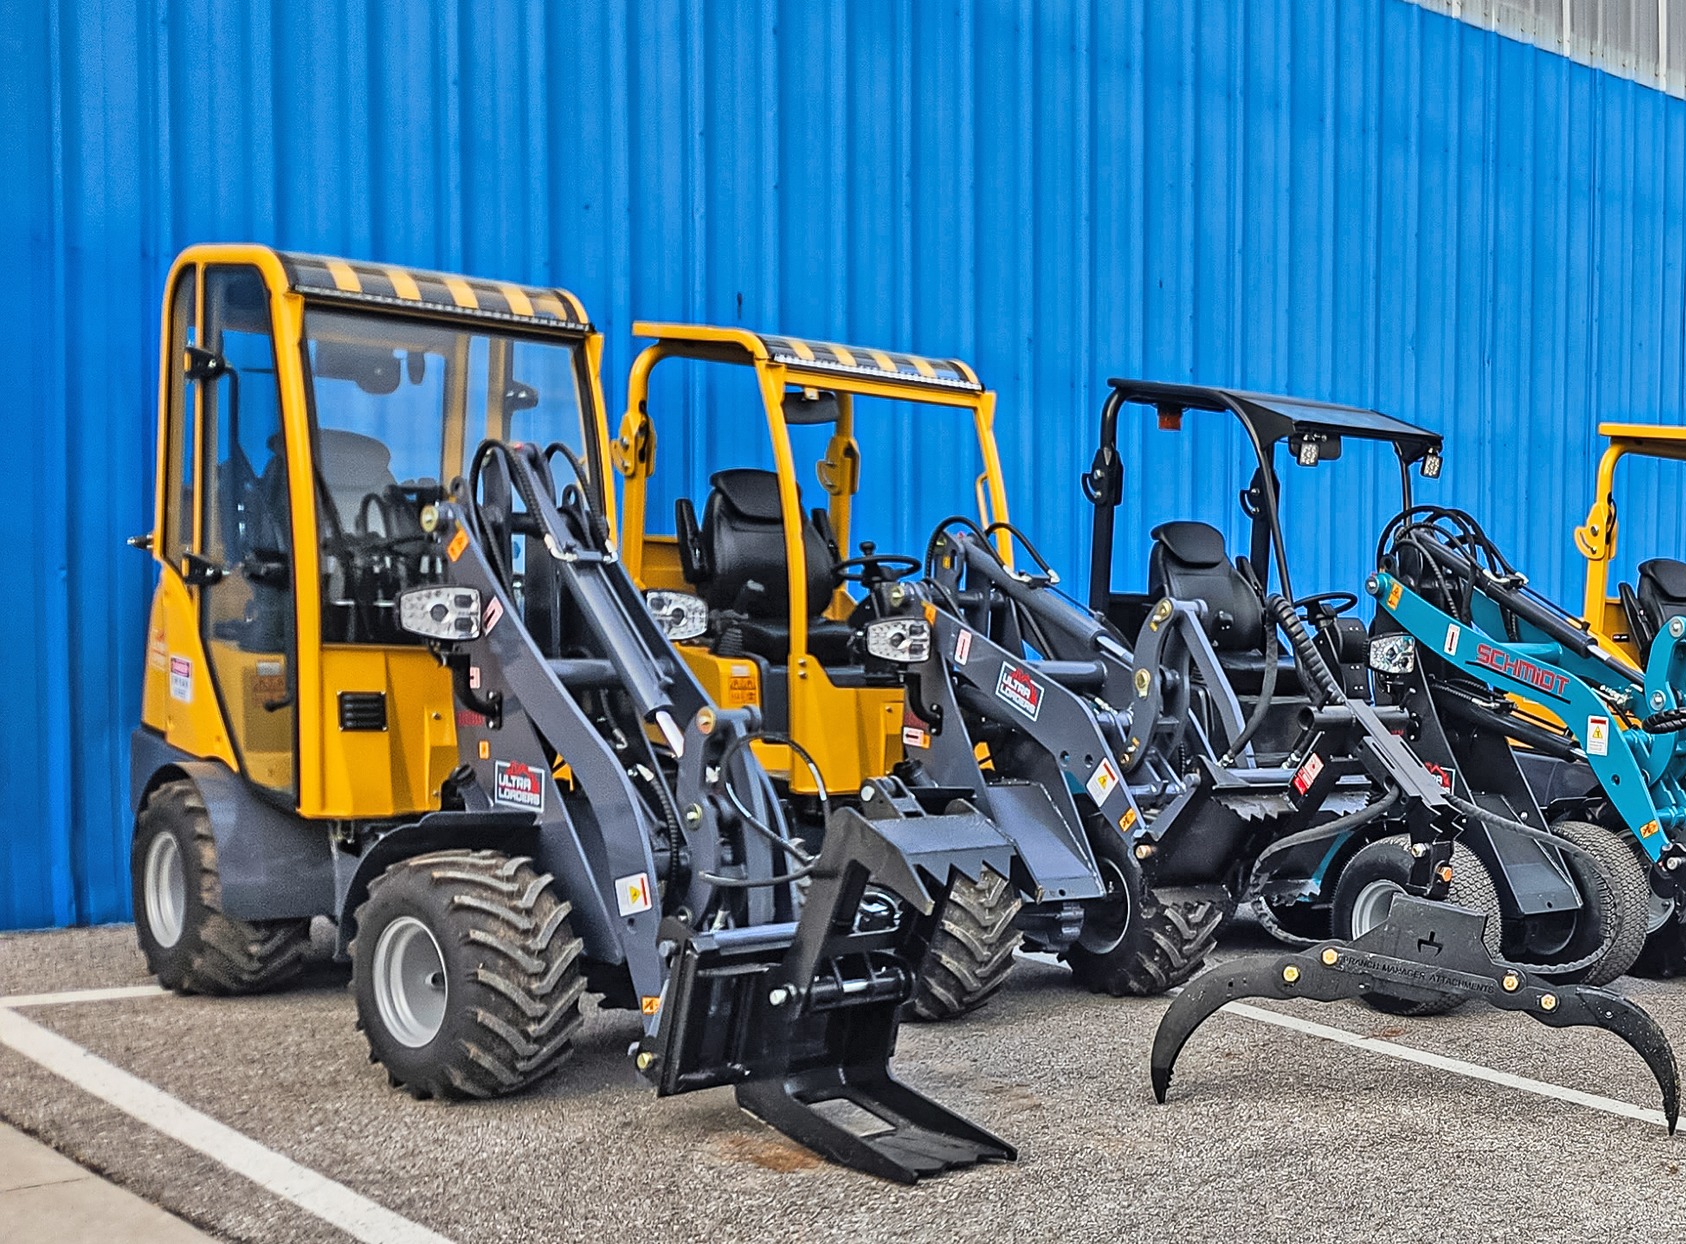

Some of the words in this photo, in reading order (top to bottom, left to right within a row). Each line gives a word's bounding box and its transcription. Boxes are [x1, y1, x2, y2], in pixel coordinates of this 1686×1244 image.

[1477, 643, 1570, 696] SCHMIDT
[1000, 683, 1036, 714] LOADERS
[1002, 672, 1031, 699] ULTRA
[499, 773, 531, 791] ULTRA
[499, 786, 540, 806] LOADERS
[1382, 963, 1425, 980] MANAGER
[1429, 974, 1494, 994] ATTACHMENTS
